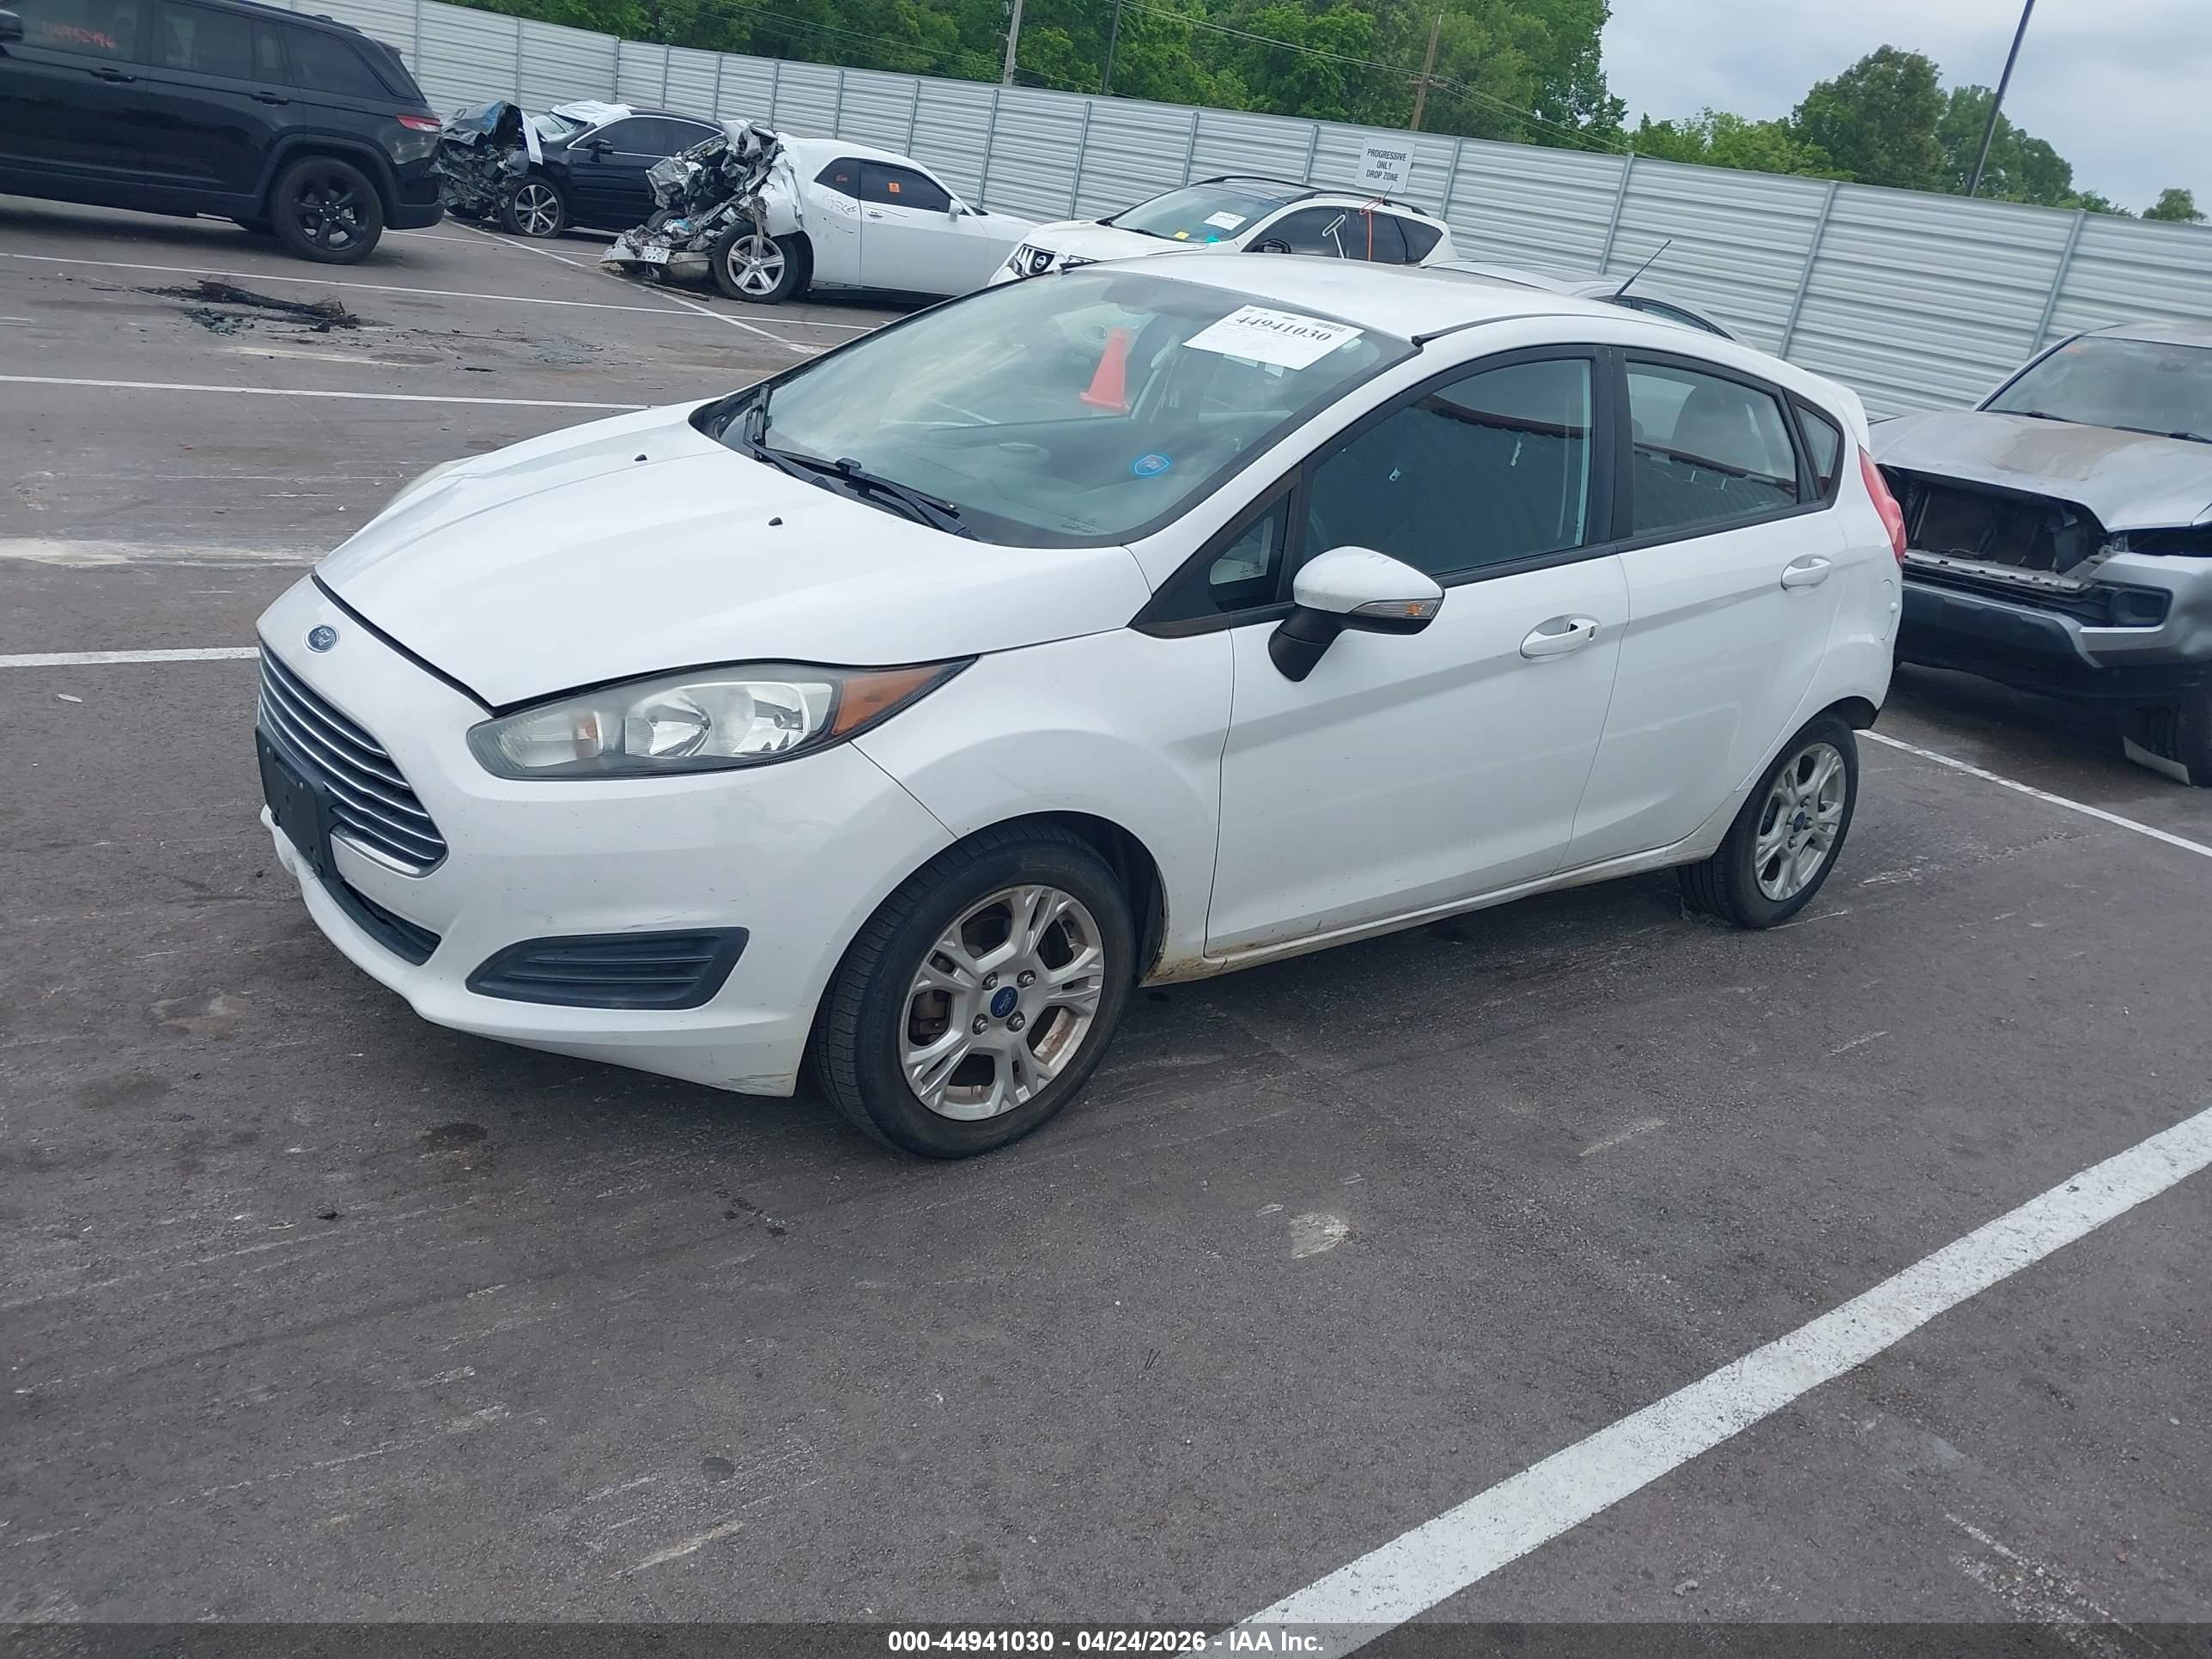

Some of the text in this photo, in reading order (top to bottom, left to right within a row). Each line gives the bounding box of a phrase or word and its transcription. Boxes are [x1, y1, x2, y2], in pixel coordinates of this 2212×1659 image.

[1367, 149, 1407, 161] PROGRESSIVE
[1376, 161, 1393, 170] ONLY
[1366, 169, 1399, 181] DROP ZONE
[1237, 316, 1332, 341] 44941030
